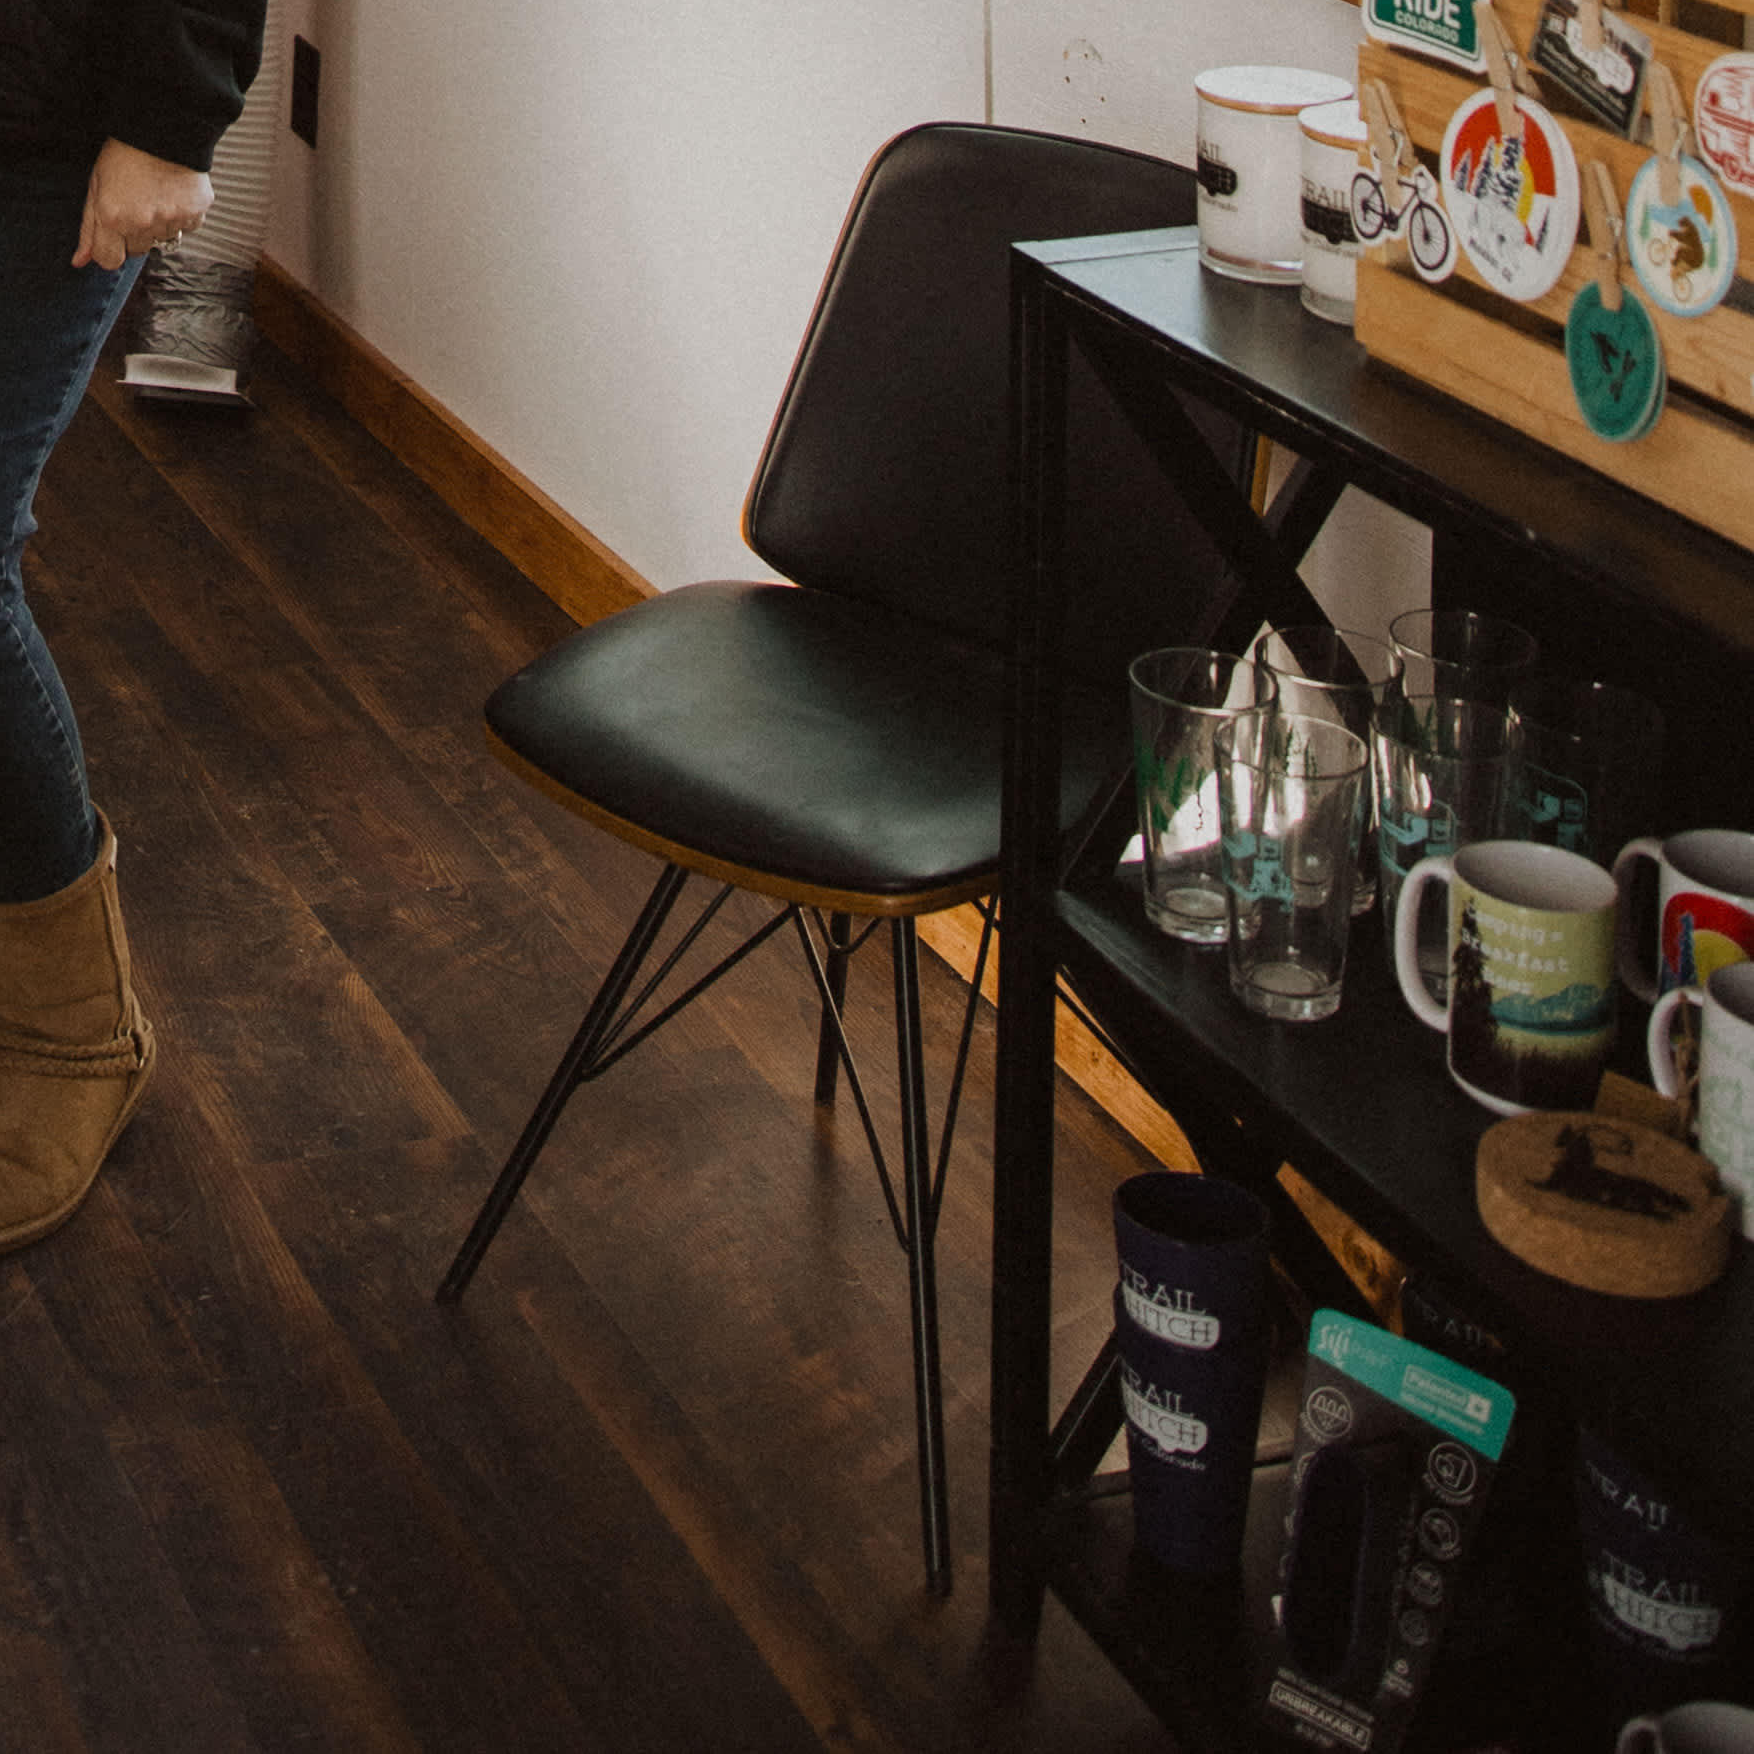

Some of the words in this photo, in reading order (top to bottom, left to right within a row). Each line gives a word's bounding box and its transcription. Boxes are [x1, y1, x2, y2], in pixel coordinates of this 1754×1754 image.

[1394, 9, 1461, 44] COLORADO
[1460, 925, 1569, 973] Breakfast
[1121, 1258, 1208, 1316] TRAIL
[1125, 1298, 1213, 1344] HITCH
[1123, 1388, 1200, 1446] HITCH
[1275, 1686, 1369, 1743] UNBREAKABLE
